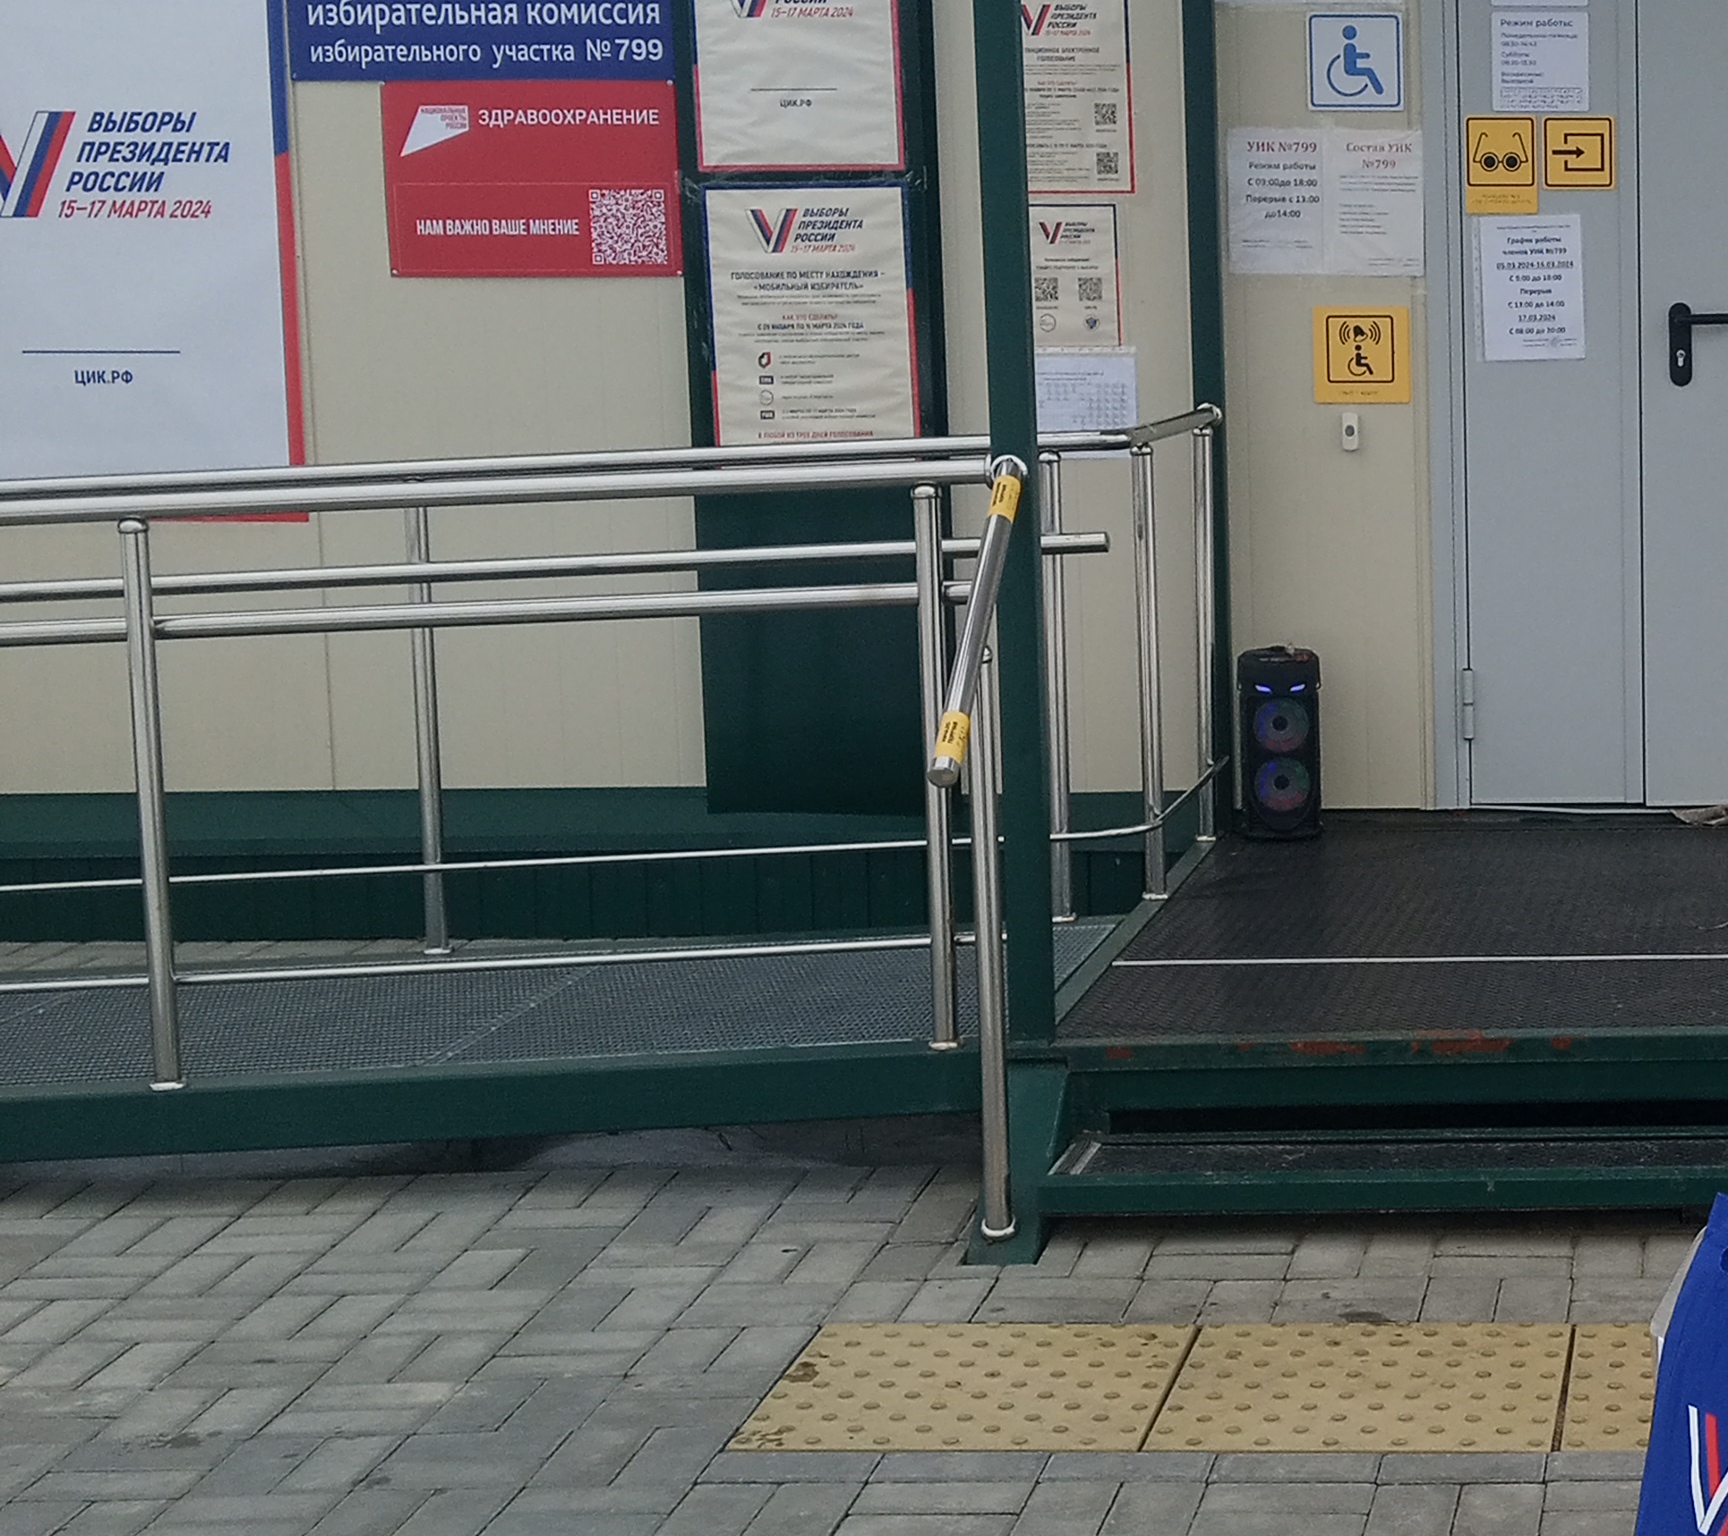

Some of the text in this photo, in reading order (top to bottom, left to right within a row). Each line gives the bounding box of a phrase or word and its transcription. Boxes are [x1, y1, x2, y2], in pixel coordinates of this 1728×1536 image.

[527, 2, 660, 26] комиссия
[799, 7, 829, 18] МАРТА
[830, 7, 854, 17] 2024
[310, 38, 482, 70] избирательного
[492, 43, 575, 68] участка
[87, 111, 197, 134] ВЫБОРЫ
[478, 108, 660, 129] ЗДРАВООХРАНЕНИЕ
[76, 141, 231, 166] ПРЕЗИДЕНТА
[1247, 141, 1276, 153] УИК
[1346, 142, 1413, 153] Состав УИК
[65, 171, 165, 193] РОССИИ
[107, 200, 167, 219] МАРТА
[168, 200, 213, 219] 2024
[802, 207, 850, 218] ВЫБОРЫ
[416, 219, 580, 236] НАМ ВАЖНО ВАШЕ МНЕНИЕ
[797, 219, 864, 230] ПРЕЗИДЕНТА
[794, 233, 836, 243] РОССИИ
[730, 271, 785, 281] ГОЛОСОВАНИЕ
[786, 271, 797, 280] ПО
[799, 271, 824, 280] МЕСТУ
[74, 369, 134, 387] ЦИК.РФ
